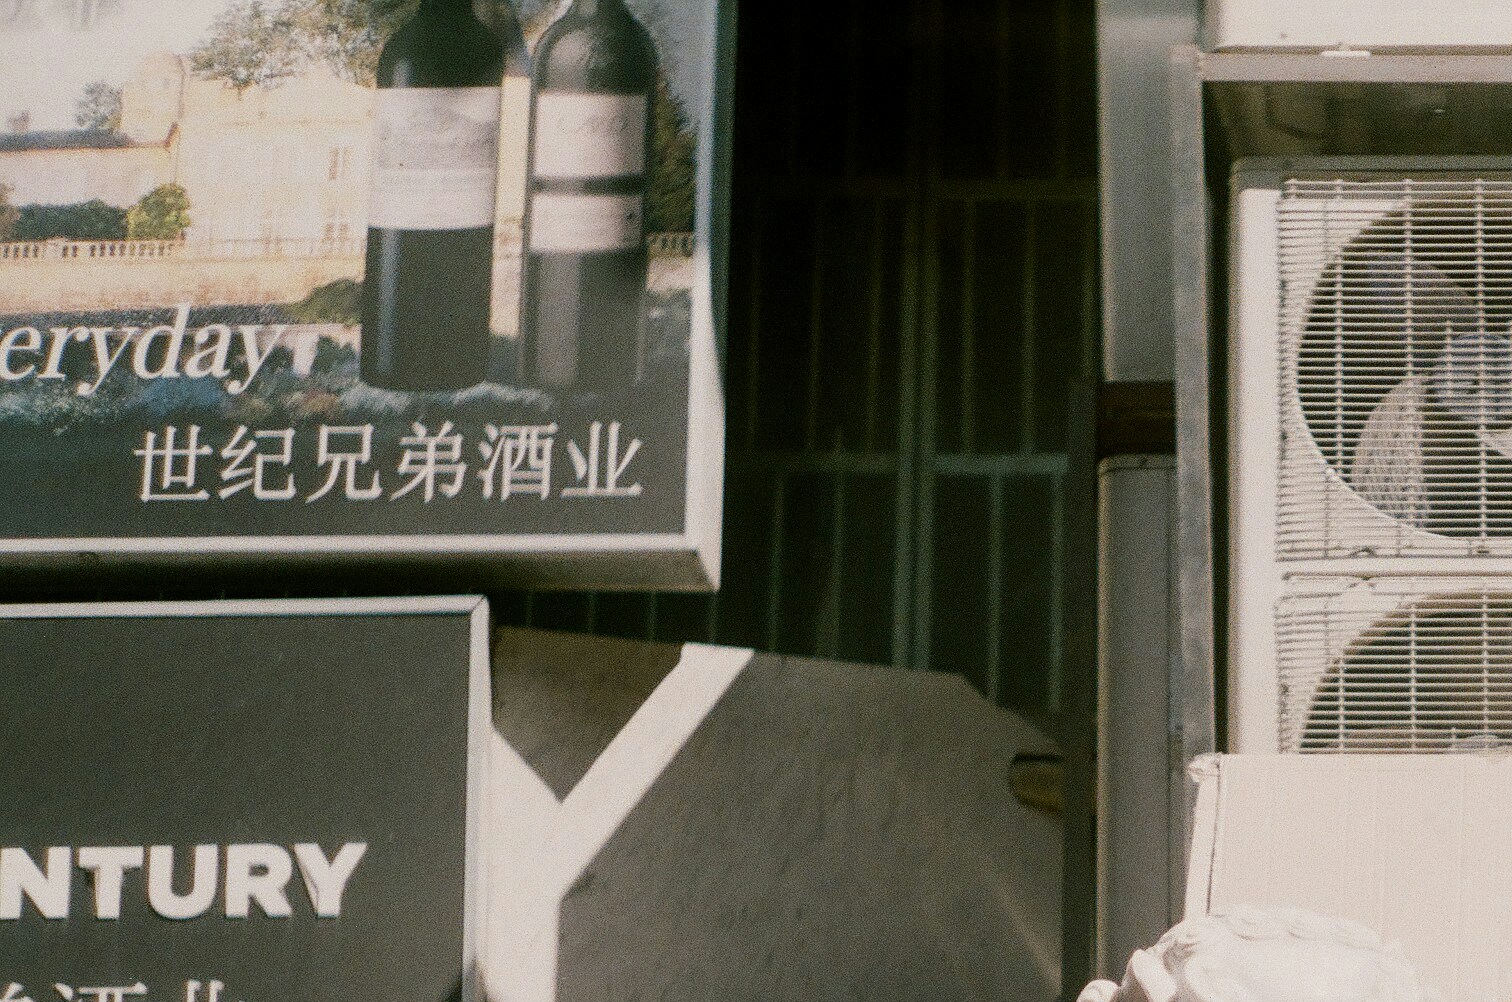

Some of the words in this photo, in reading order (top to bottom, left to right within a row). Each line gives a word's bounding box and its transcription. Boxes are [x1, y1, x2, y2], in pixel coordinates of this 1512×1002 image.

[0, 304, 284, 395] eryday
[134, 421, 644, 503] 世纪兄弟酒业
[0, 842, 368, 920] NTURY
